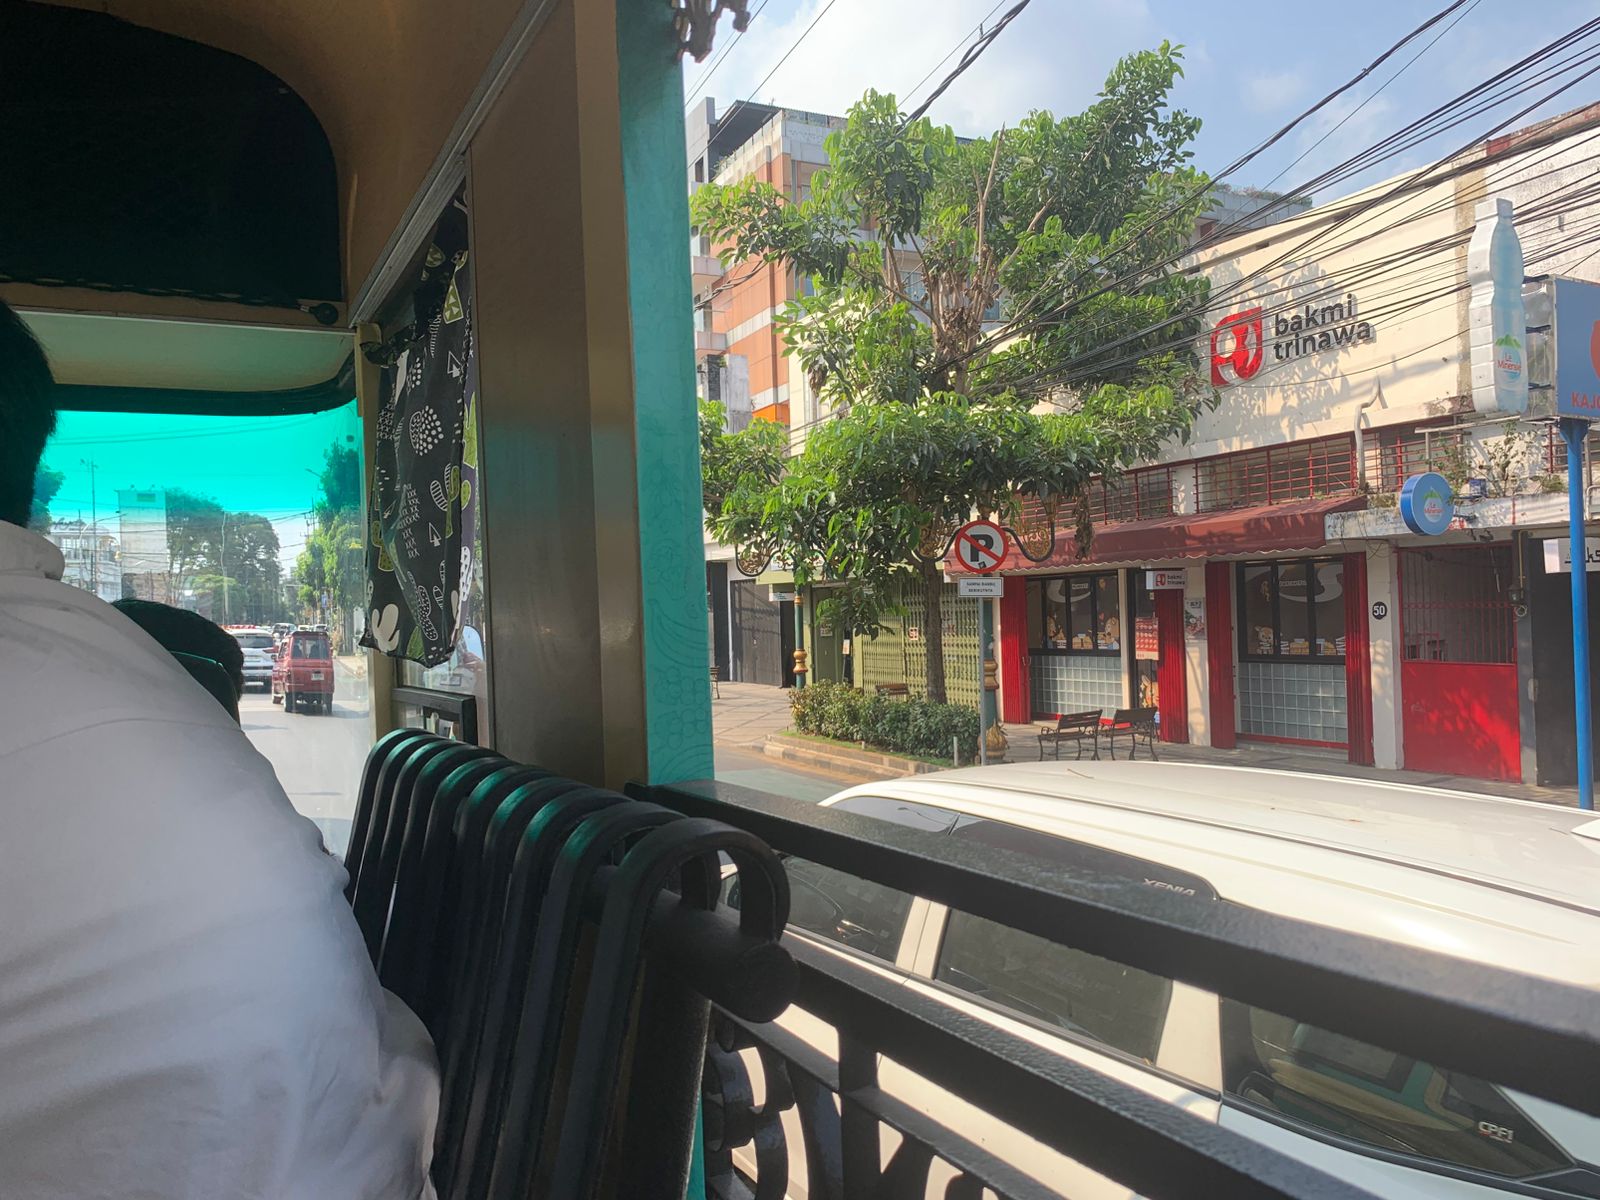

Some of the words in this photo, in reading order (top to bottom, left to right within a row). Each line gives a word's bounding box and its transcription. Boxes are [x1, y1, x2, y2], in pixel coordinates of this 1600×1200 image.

[1274, 293, 1354, 337] bakmi
[1273, 321, 1372, 361] trinawa
[1373, 605, 1385, 616] 50
[1143, 878, 1196, 896] XENIA
